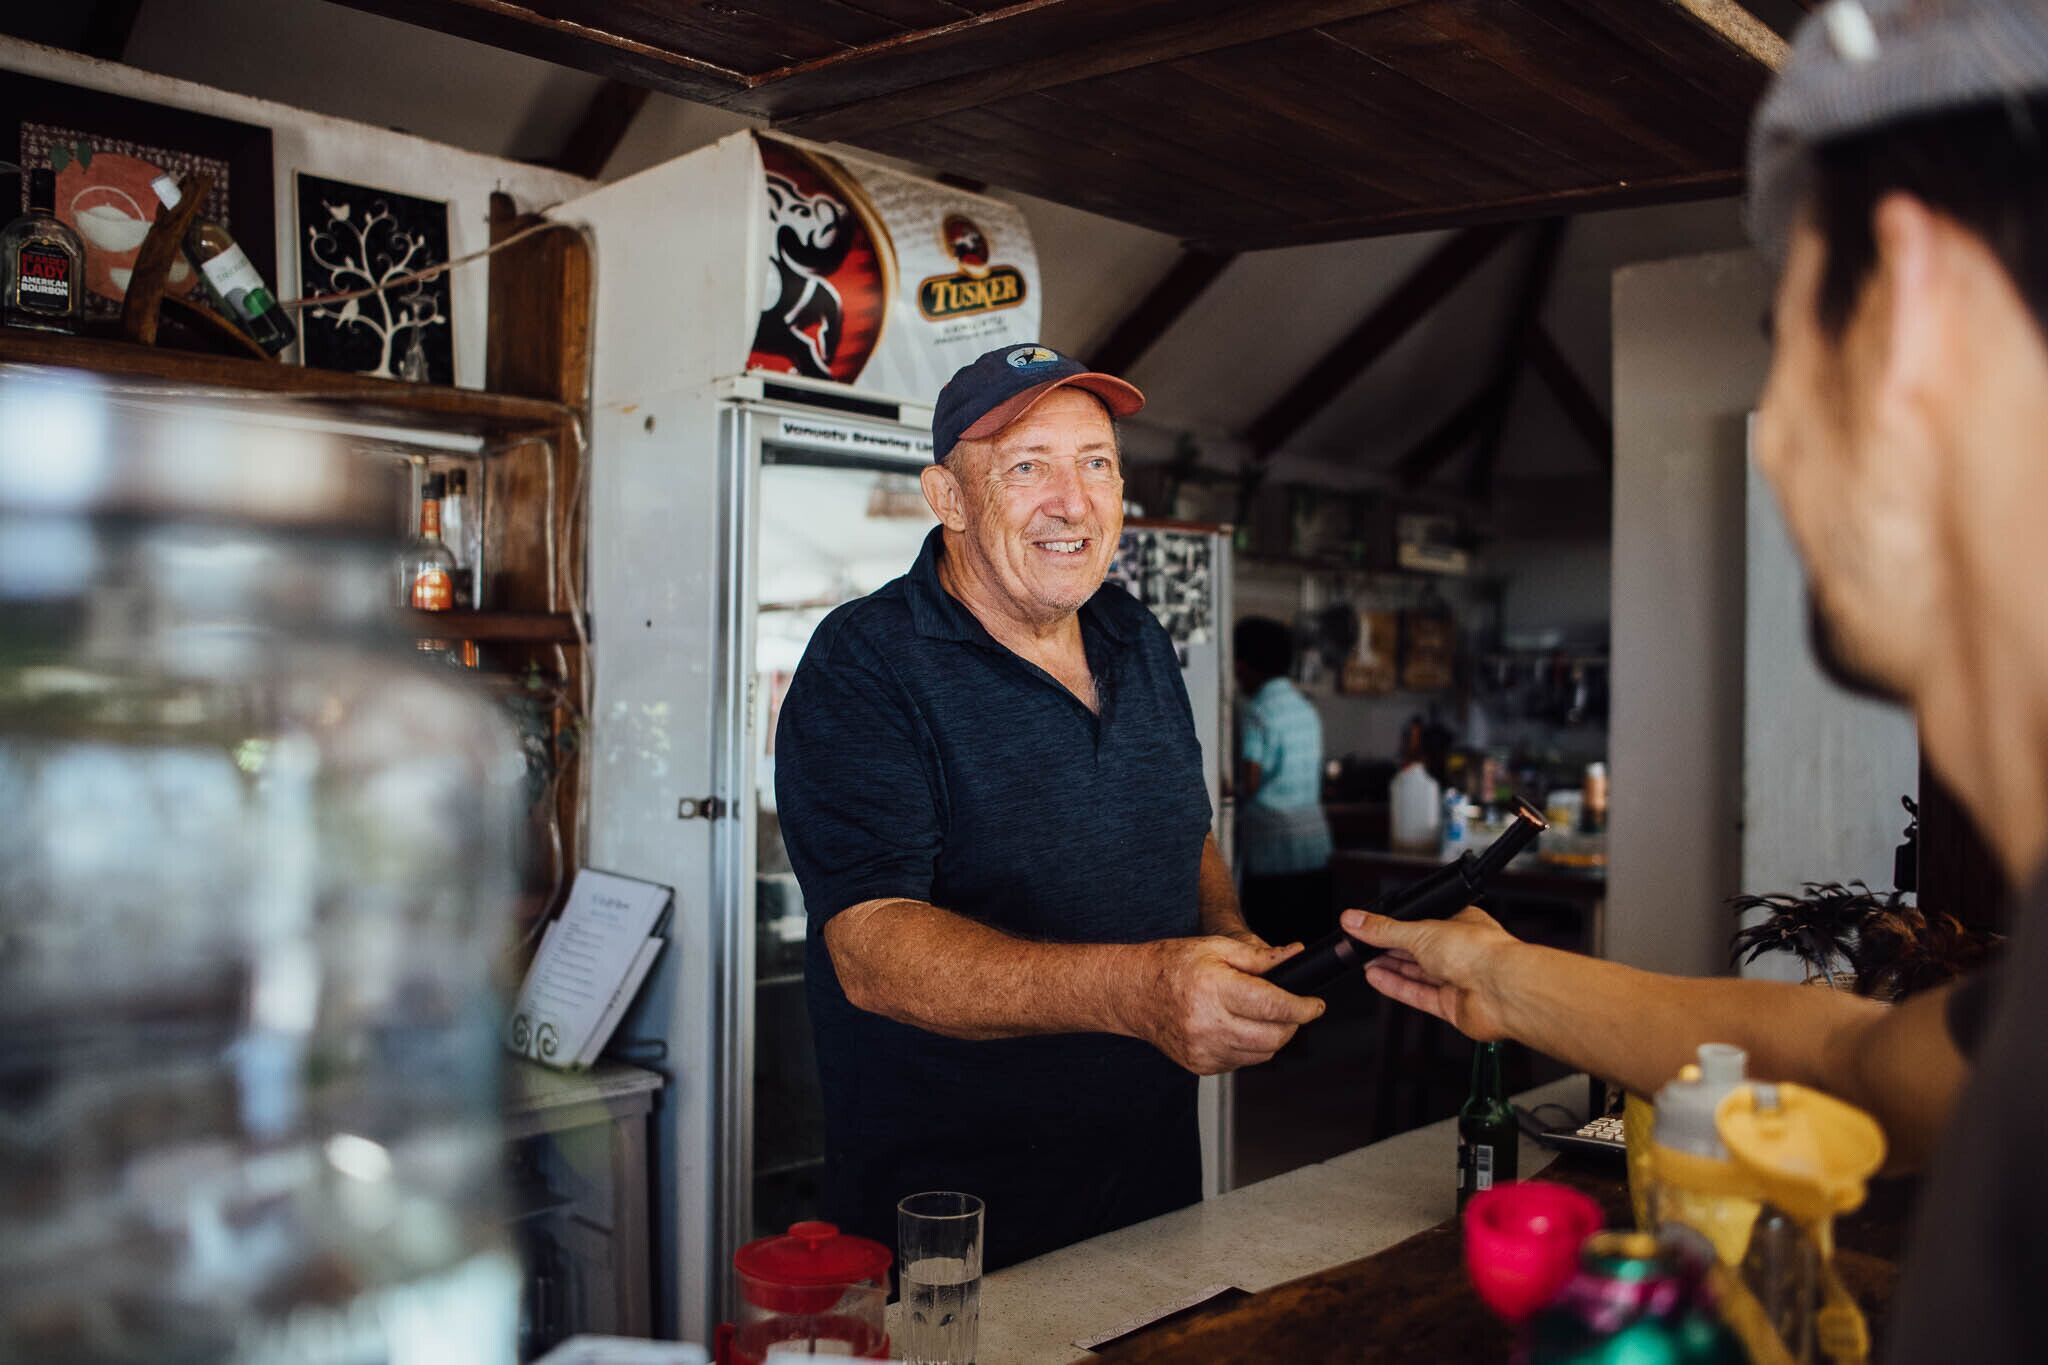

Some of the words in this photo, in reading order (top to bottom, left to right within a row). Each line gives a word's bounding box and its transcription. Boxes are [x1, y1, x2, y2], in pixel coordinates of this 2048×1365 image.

[22, 262, 68, 281] LADY
[21, 275, 68, 288] AMERICAN
[21, 283, 68, 296] BOURBON
[931, 275, 1018, 312] TUSKER
[853, 431, 911, 451] Brewing
